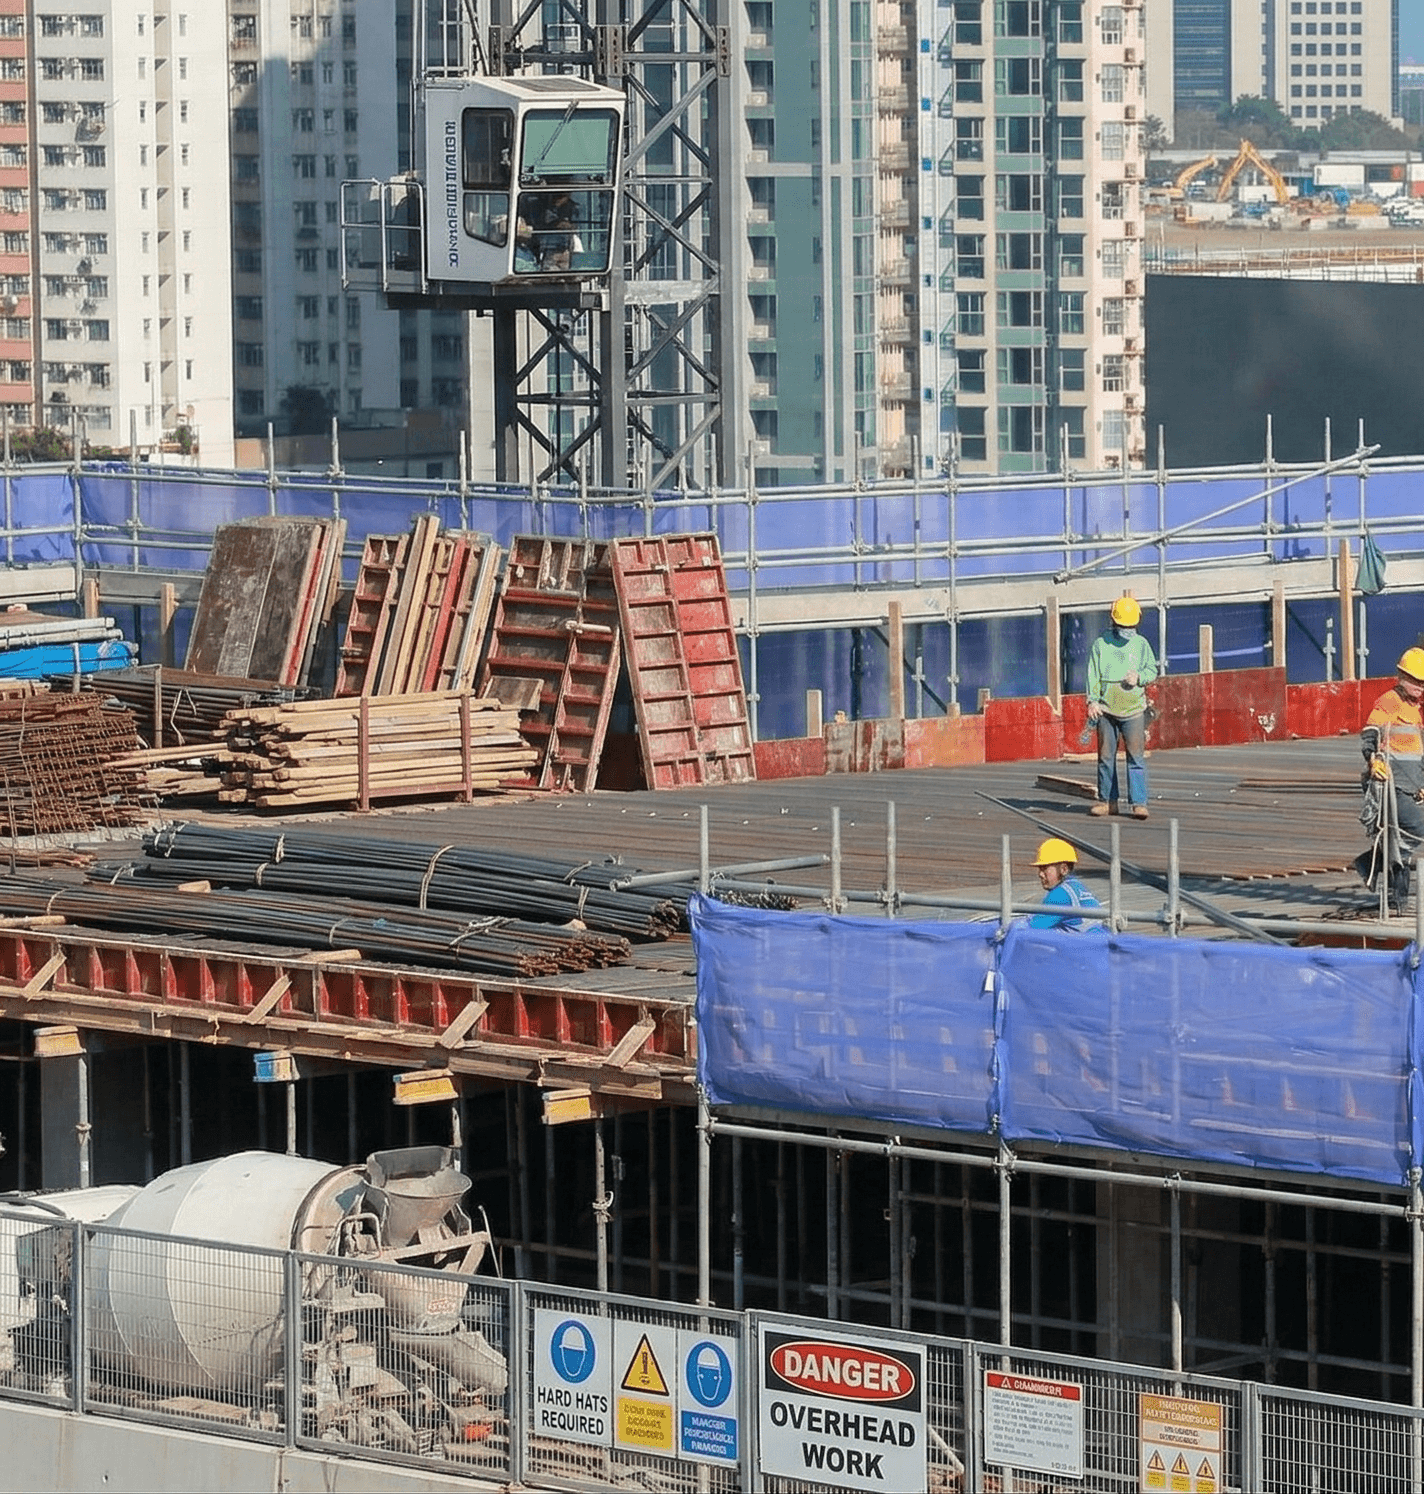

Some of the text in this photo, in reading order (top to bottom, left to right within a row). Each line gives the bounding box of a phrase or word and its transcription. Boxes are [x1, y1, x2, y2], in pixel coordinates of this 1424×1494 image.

[784, 1349, 901, 1393] DANGER
[537, 1386, 572, 1408] HARD
[576, 1392, 608, 1414] HATS
[541, 1409, 604, 1436] REQUIRED
[770, 1401, 916, 1448] OVERHEAD
[802, 1442, 884, 1480] WORK
